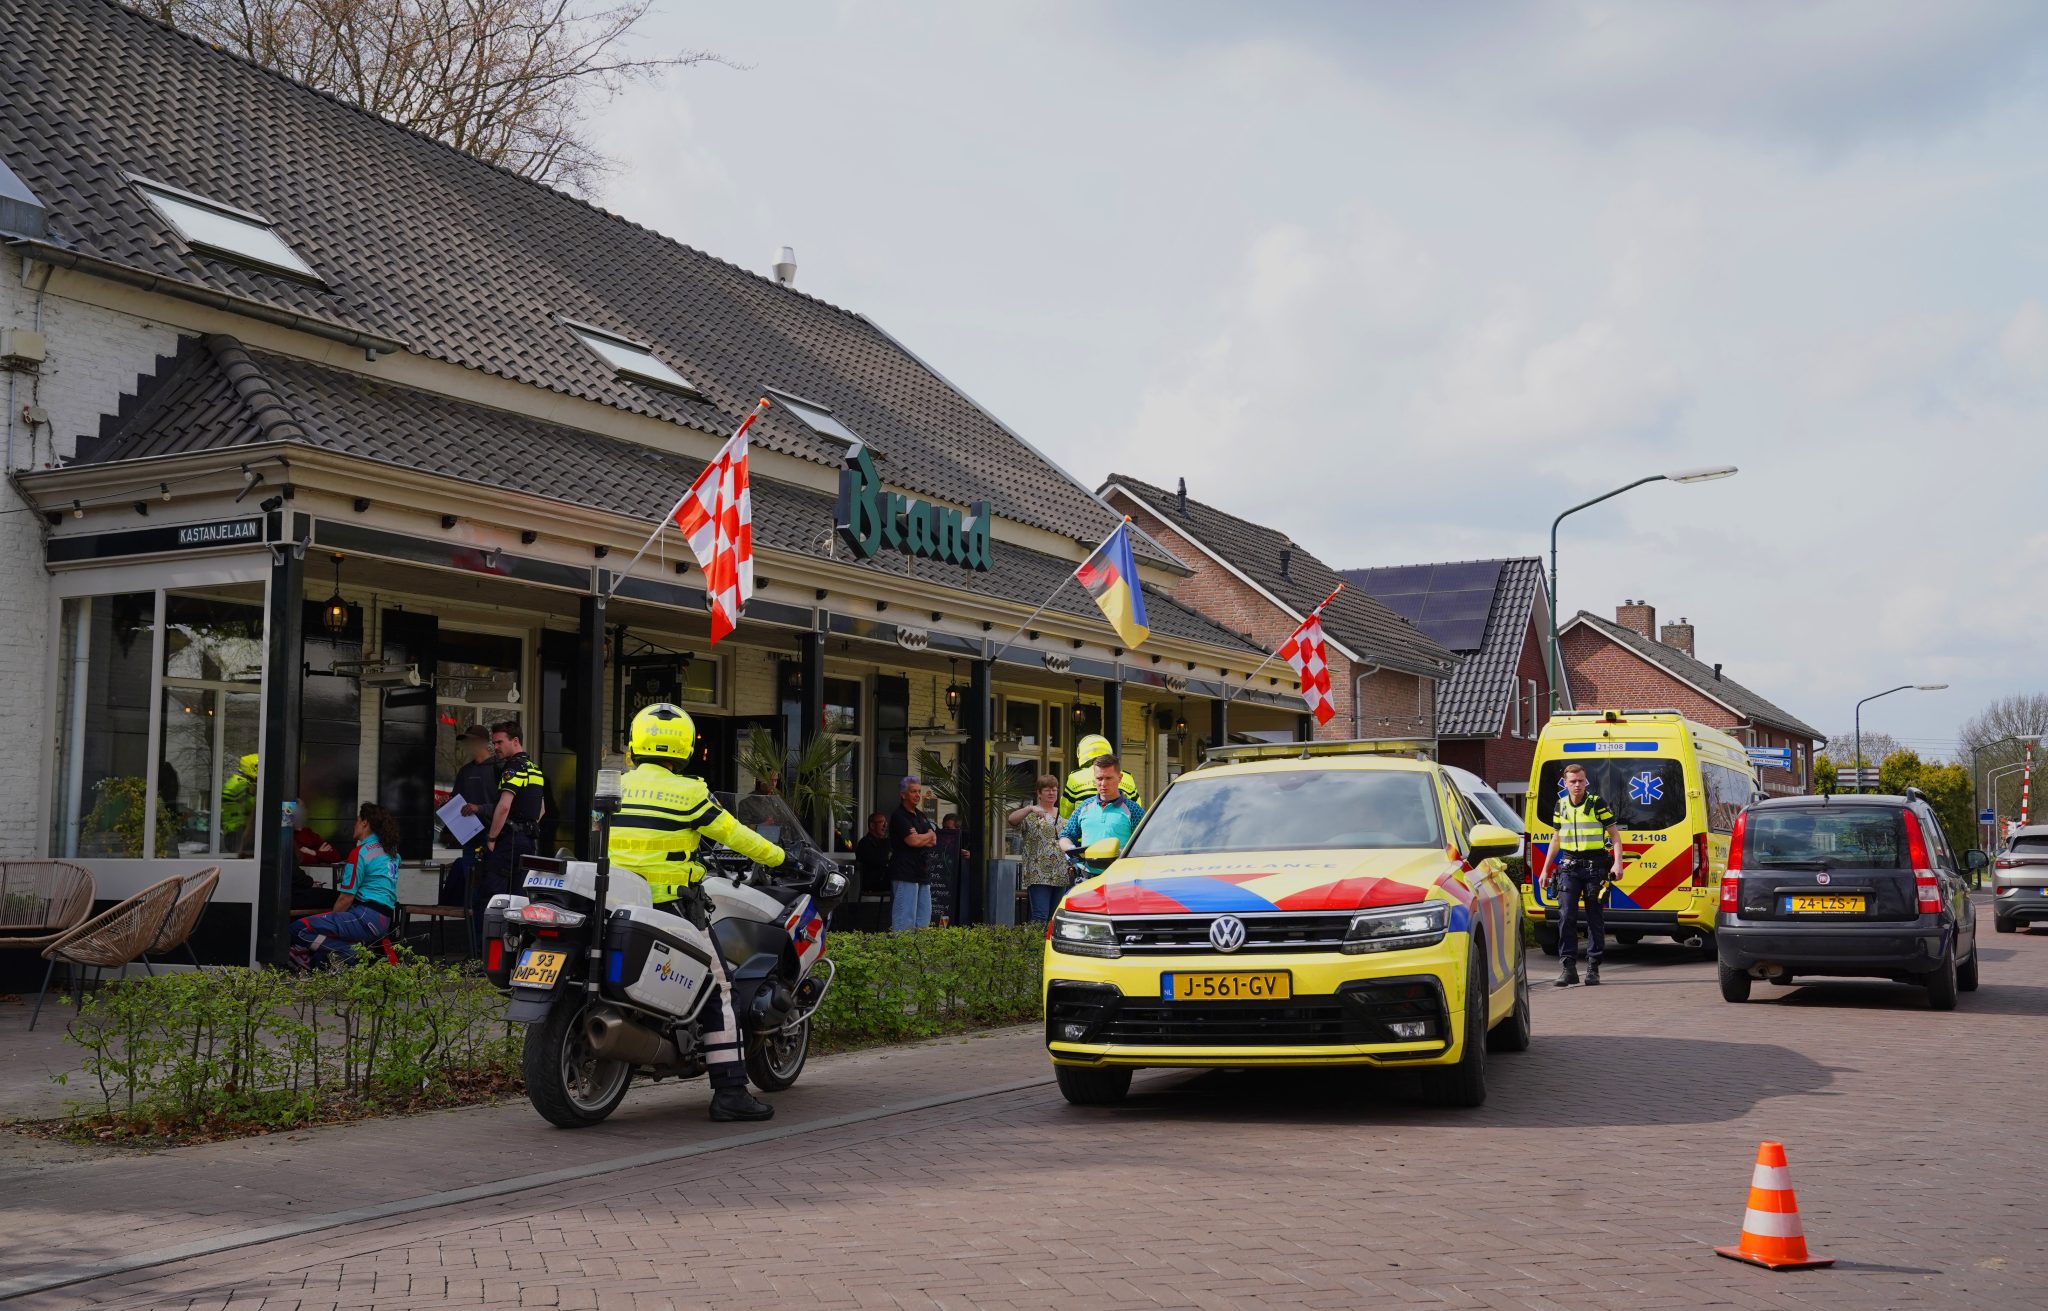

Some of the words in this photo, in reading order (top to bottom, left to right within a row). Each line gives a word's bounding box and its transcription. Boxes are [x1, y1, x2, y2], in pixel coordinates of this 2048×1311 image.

[840, 443, 994, 572] Brand
[180, 522, 256, 543] KASTANJELAAN
[621, 788, 663, 801] LITIE
[1632, 834, 1667, 842] 21-108
[1159, 863, 1338, 874] AMBULANCE
[527, 877, 564, 888] POLITIE
[1798, 897, 1858, 910] 24-LZS-7
[537, 953, 555, 967] 93
[514, 966, 558, 983] MP-TH
[655, 963, 693, 990] POLITIE
[1183, 976, 1276, 997] J-561-GV
